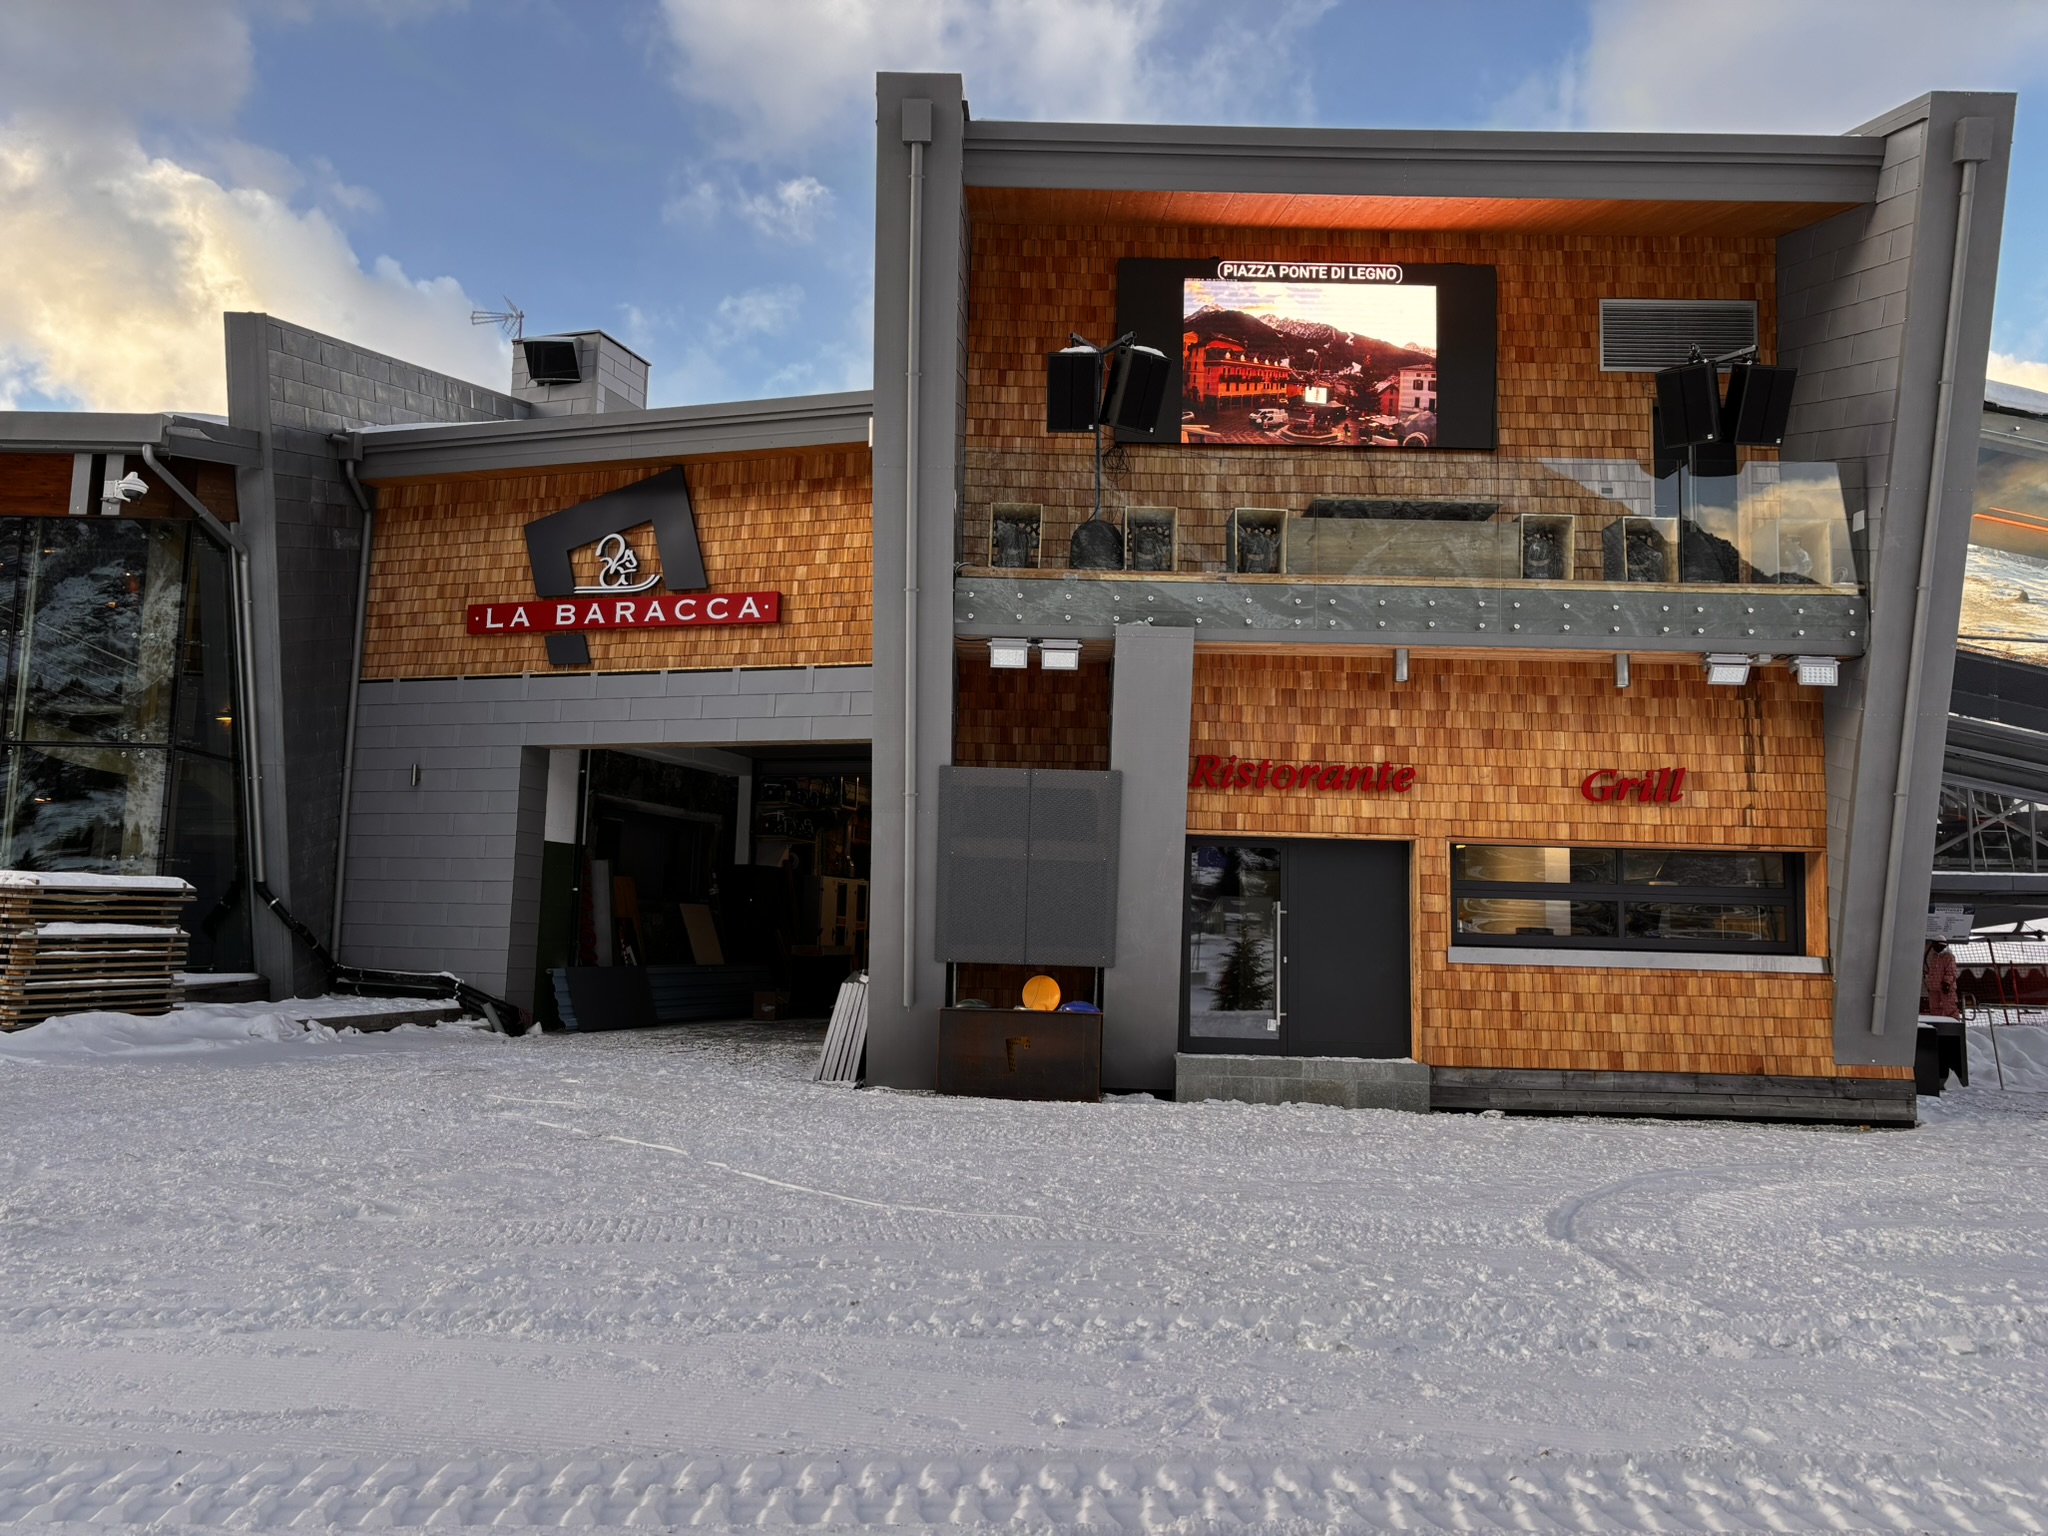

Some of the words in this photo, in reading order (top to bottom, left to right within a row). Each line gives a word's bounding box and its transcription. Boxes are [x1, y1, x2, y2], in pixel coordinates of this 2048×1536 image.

[1223, 264, 1276, 278] PIAZZA
[1279, 265, 1327, 279] PONTE
[1331, 266, 1345, 279] DI
[1348, 267, 1397, 280] LEGNO
[485, 606, 530, 629] LA
[555, 596, 761, 625] BARACCA
[1188, 754, 1416, 792] Ristorante
[1581, 766, 1686, 803] Grill
